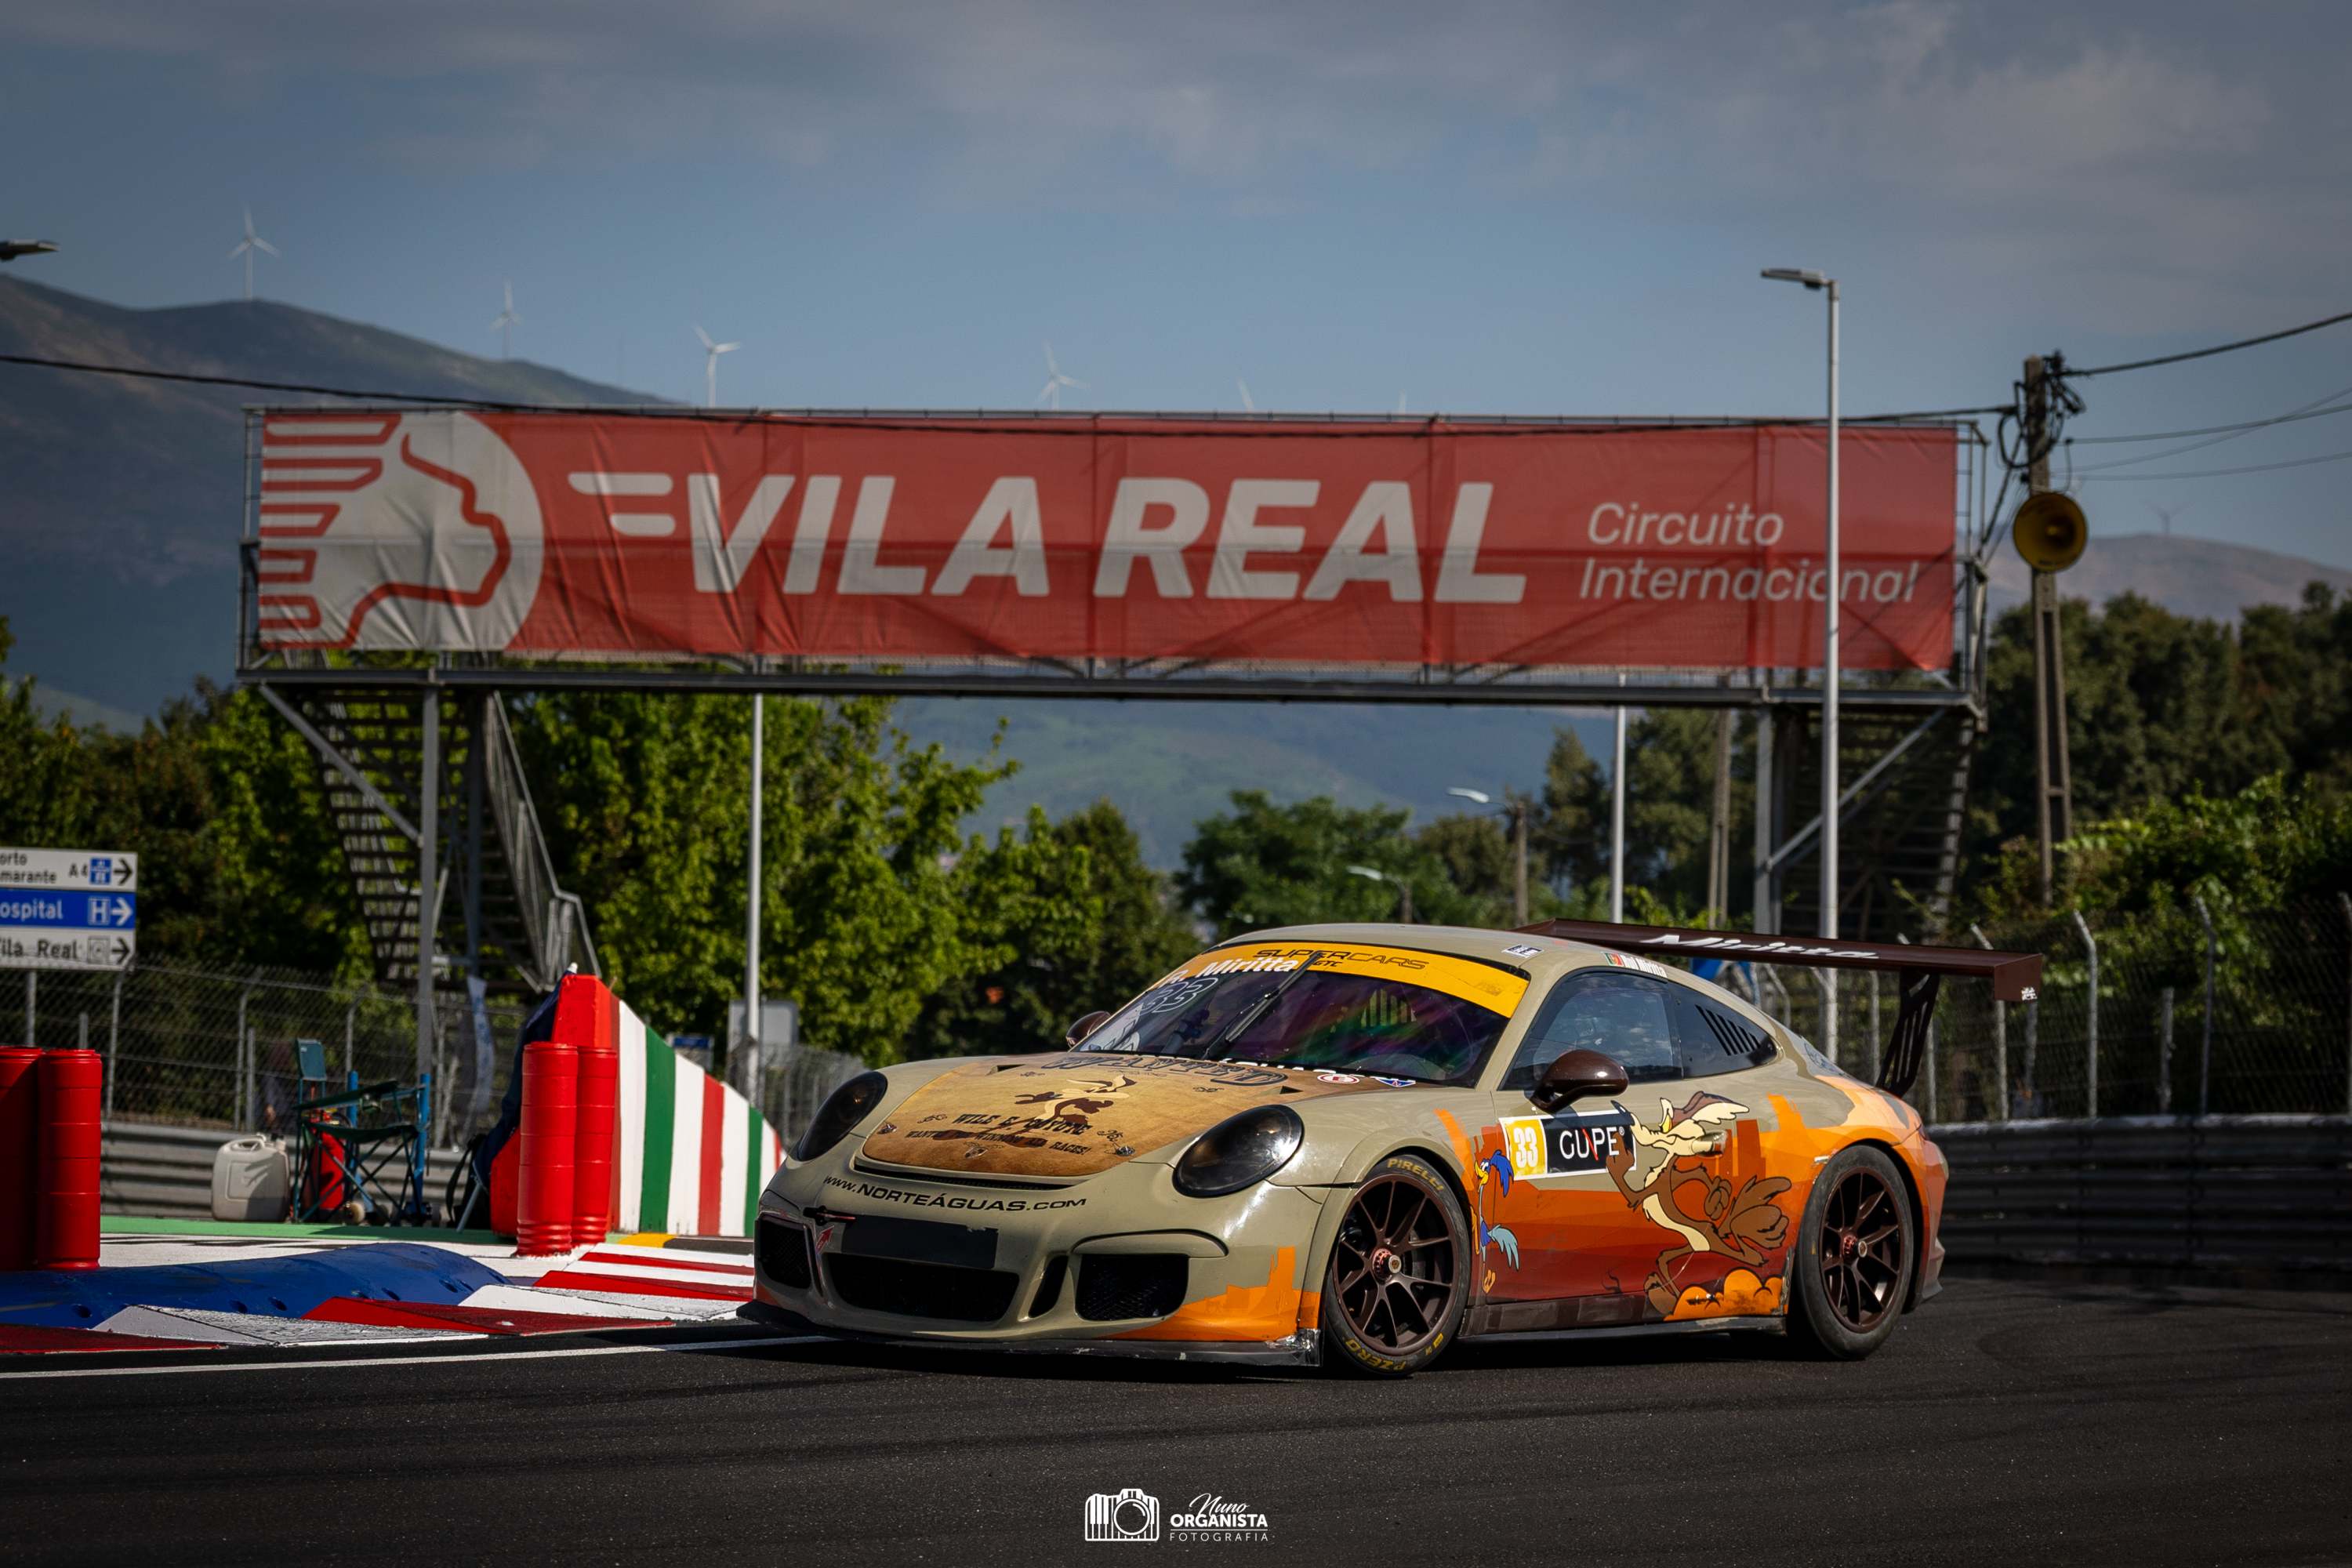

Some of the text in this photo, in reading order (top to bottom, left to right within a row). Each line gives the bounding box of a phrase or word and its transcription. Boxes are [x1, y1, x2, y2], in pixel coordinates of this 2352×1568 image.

[1588, 502, 1784, 546] Circuito
[688, 473, 1526, 604] VILA REAL
[1579, 557, 1920, 602] Internacional
[0, 852, 27, 866] orto
[0, 870, 56, 884] marante
[0, 898, 64, 922] ospital
[0, 936, 78, 959] ila Real
[1195, 956, 1299, 978] Miritta
[952, 1113, 1001, 1125] WILE
[1513, 1127, 1539, 1168] 33
[1387, 1158, 1444, 1192] PIRELLI
